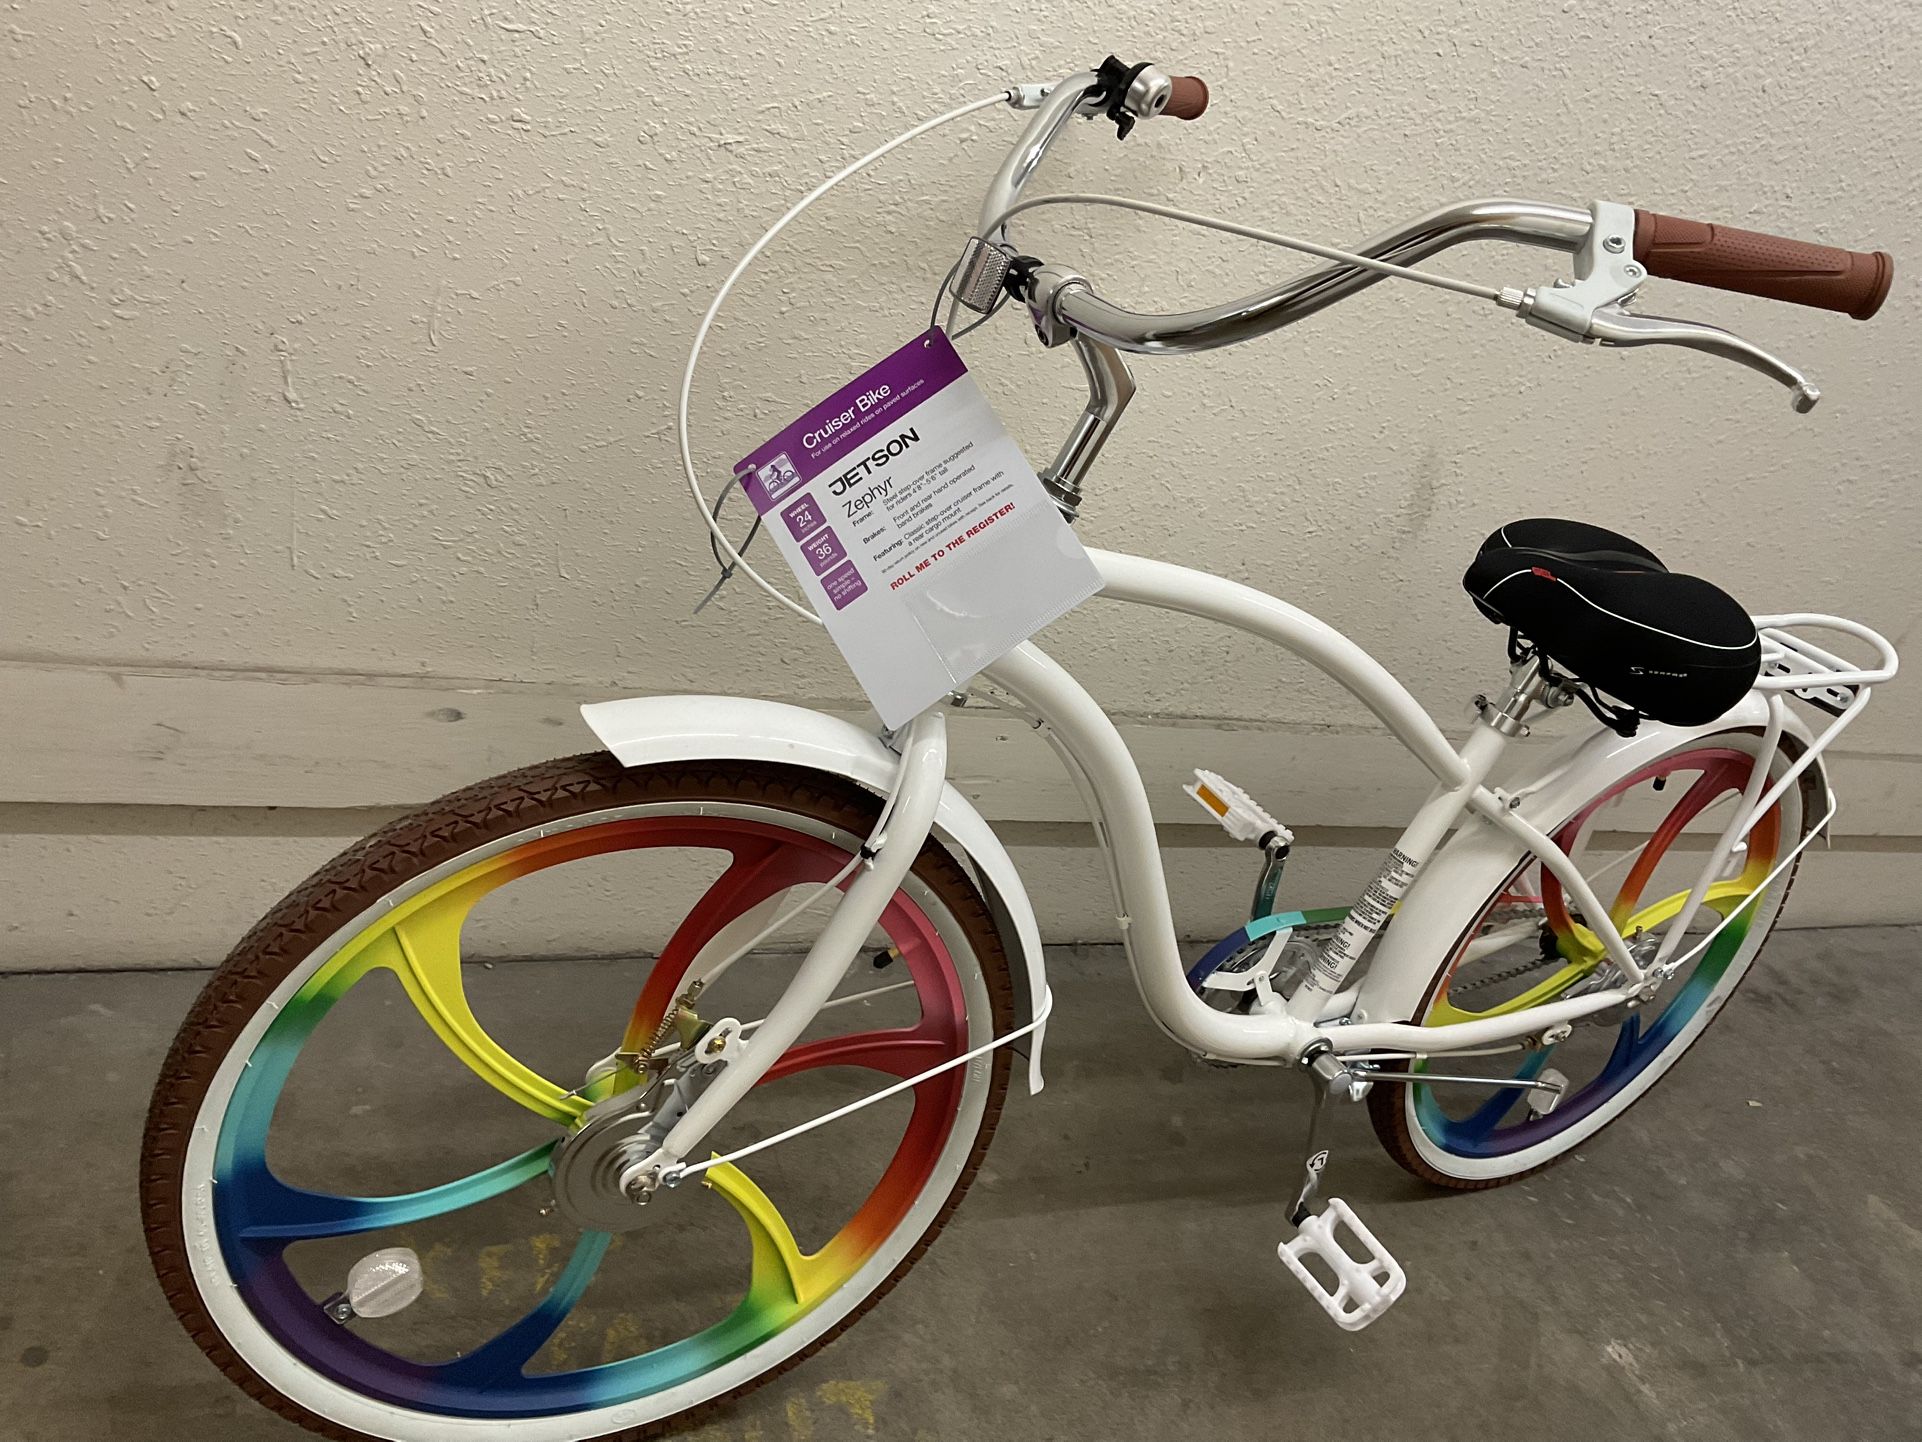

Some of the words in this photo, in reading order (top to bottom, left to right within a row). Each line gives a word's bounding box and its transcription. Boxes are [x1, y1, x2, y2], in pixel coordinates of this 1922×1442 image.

[802, 406, 856, 449] Cruiser
[855, 384, 891, 412] Bike
[811, 450, 821, 459] For
[821, 443, 832, 452] use
[832, 437, 840, 445] on
[839, 422, 861, 439] relaxed
[860, 412, 875, 425] rides
[874, 407, 883, 415] on
[882, 394, 901, 410] paved
[900, 379, 924, 397] surfaces
[828, 427, 920, 497] JETSON
[852, 510, 874, 527] Frame:
[882, 492, 898, 506] Steel
[898, 474, 927, 497] step-over
[925, 462, 943, 476] frame
[943, 441, 974, 465] suggested
[789, 502, 809, 518] WHEEL
[841, 475, 894, 519] Zephyr
[863, 526, 886, 544] Brakes:
[892, 509, 909, 523] Front
[909, 501, 921, 512] and
[921, 493, 933, 504] rear
[932, 482, 949, 496] hand
[948, 464, 976, 485] operated
[886, 503, 895, 512] for
[895, 492, 912, 506] riders
[938, 466, 948, 476] tall
[796, 510, 812, 527] 24
[873, 538, 904, 562] Featuring:
[903, 523, 925, 540] Classic
[925, 504, 953, 526] step-over
[953, 491, 973, 507] cruiser
[972, 479, 991, 493] frame
[990, 471, 1004, 481] with
[896, 515, 913, 529] band
[912, 502, 933, 518] brakes
[912, 532, 924, 543] rear
[924, 520, 942, 535] cargo
[941, 507, 962, 523] mount
[807, 534, 829, 551] WEIGHT
[815, 543, 832, 559] 36
[890, 571, 915, 590] ROLL
[915, 559, 931, 573] ME
[931, 549, 945, 561] TO
[945, 535, 965, 551] THE
[965, 502, 1015, 538] REGISTER!
